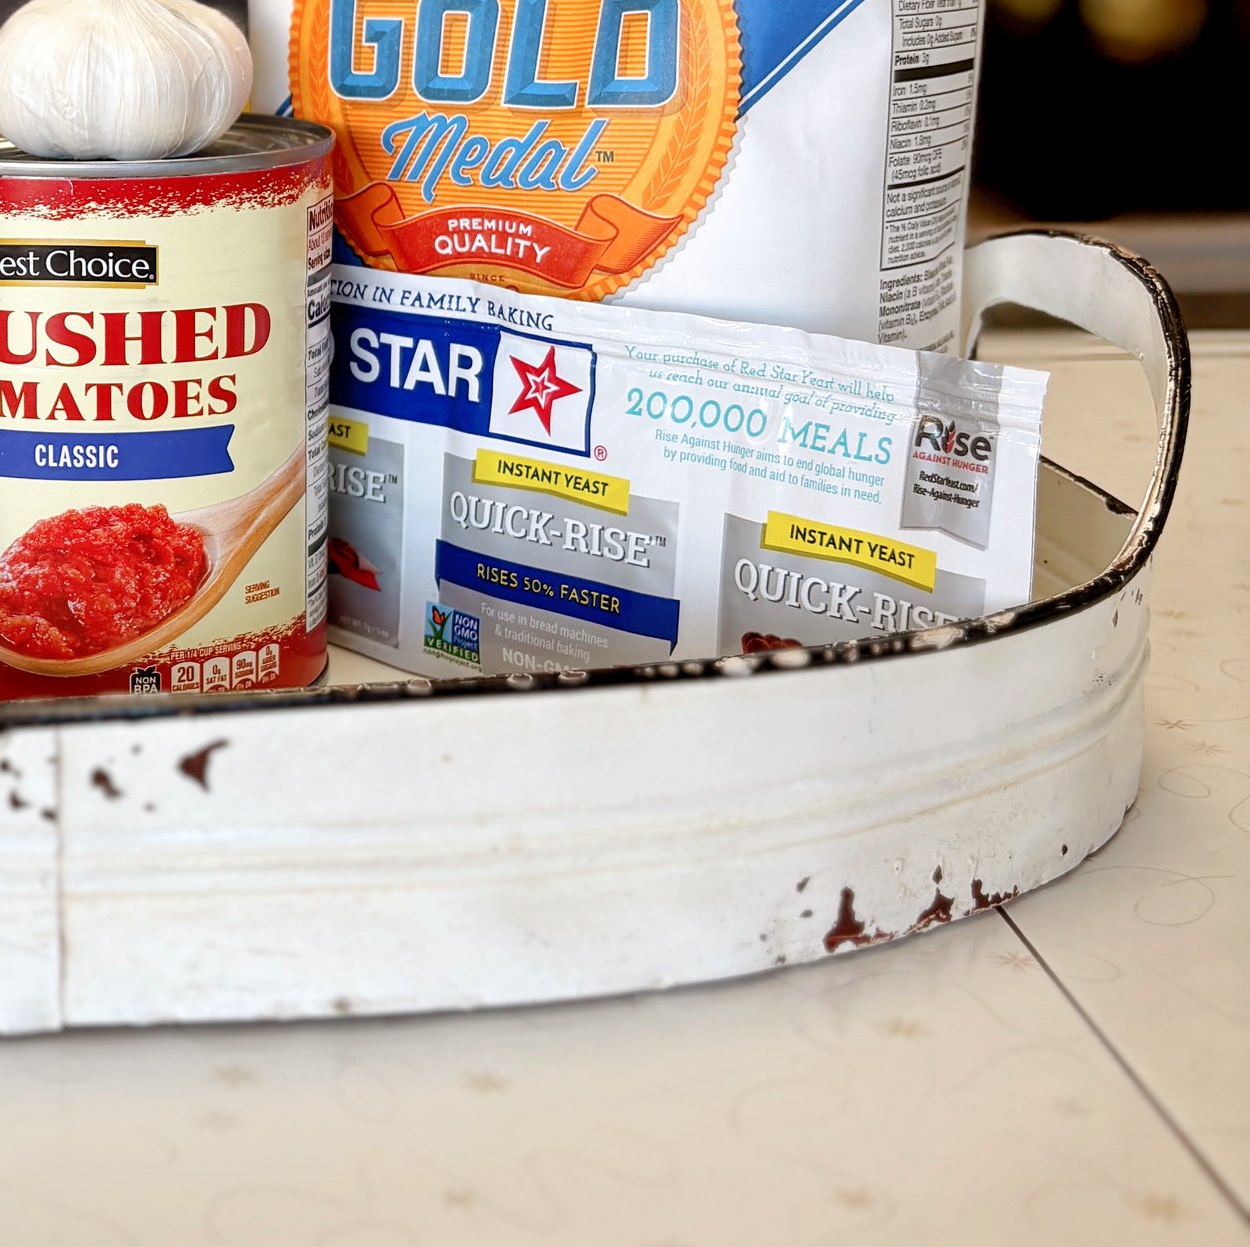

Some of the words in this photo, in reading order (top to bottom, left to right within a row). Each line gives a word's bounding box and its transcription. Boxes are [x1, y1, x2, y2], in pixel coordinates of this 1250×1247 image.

[380, 110, 610, 204] Medal
[447, 217, 533, 237] PREMIUM
[434, 234, 551, 263] QUALITY
[469, 272, 505, 282] SINCE
[372, 287, 394, 304] IN
[400, 290, 481, 314] FAMILY
[487, 299, 555, 331] BAKING
[350, 327, 483, 403] STAR
[624, 345, 659, 362] Your
[662, 352, 719, 370] purchase
[723, 358, 738, 374] of
[740, 362, 766, 378] Red
[770, 365, 799, 383] Star
[800, 370, 835, 389] Yeast
[837, 378, 862, 396] will
[866, 383, 895, 404] help
[649, 367, 663, 379] us
[665, 371, 703, 387] reach
[707, 378, 730, 389] our
[732, 382, 781, 399] annual
[784, 389, 813, 406] goal
[815, 394, 829, 409] of
[829, 398, 896, 425] providing
[625, 387, 768, 438] 200,000
[777, 416, 893, 465] MEALS
[34, 444, 120, 469] CLASSIC
[655, 429, 678, 443] Rise
[681, 432, 721, 451] Against
[722, 440, 754, 458] Hunger
[756, 449, 781, 465] aims
[784, 454, 794, 467] to
[796, 458, 814, 472] end
[815, 460, 846, 480] global
[848, 467, 885, 489] hunger
[664, 446, 677, 461] by
[679, 448, 727, 471] providing
[729, 457, 748, 473] food
[749, 464, 767, 479] and
[769, 468, 785, 482] aid
[788, 472, 798, 485] to
[800, 474, 838, 496] families
[840, 482, 851, 497] in
[854, 486, 882, 505] need.
[913, 451, 951, 467] AGAINST
[952, 458, 988, 475] HUNGER
[497, 460, 561, 486] INSTANT
[564, 472, 609, 497] YEAST
[450, 491, 656, 567] QUICK-RISE
[790, 524, 863, 553] INSTANT
[868, 541, 915, 569] YEAST
[244, 580, 270, 594] SERVING
[244, 586, 280, 604] SUGGESTION
[477, 564, 518, 589] RISES
[523, 575, 555, 598] 50%
[560, 585, 621, 614] FASTER
[453, 625, 478, 641] GMO
[454, 614, 478, 630] NON
[481, 603, 495, 618] For
[497, 611, 516, 623] use
[518, 616, 527, 627] in
[529, 618, 559, 635] bread
[559, 626, 609, 649] machines
[427, 638, 479, 663] VERIFIED
[494, 624, 502, 636] &
[504, 627, 555, 650] traditional
[557, 640, 590, 664] baking
[135, 676, 156, 684] NON
[177, 666, 194, 683] 20
